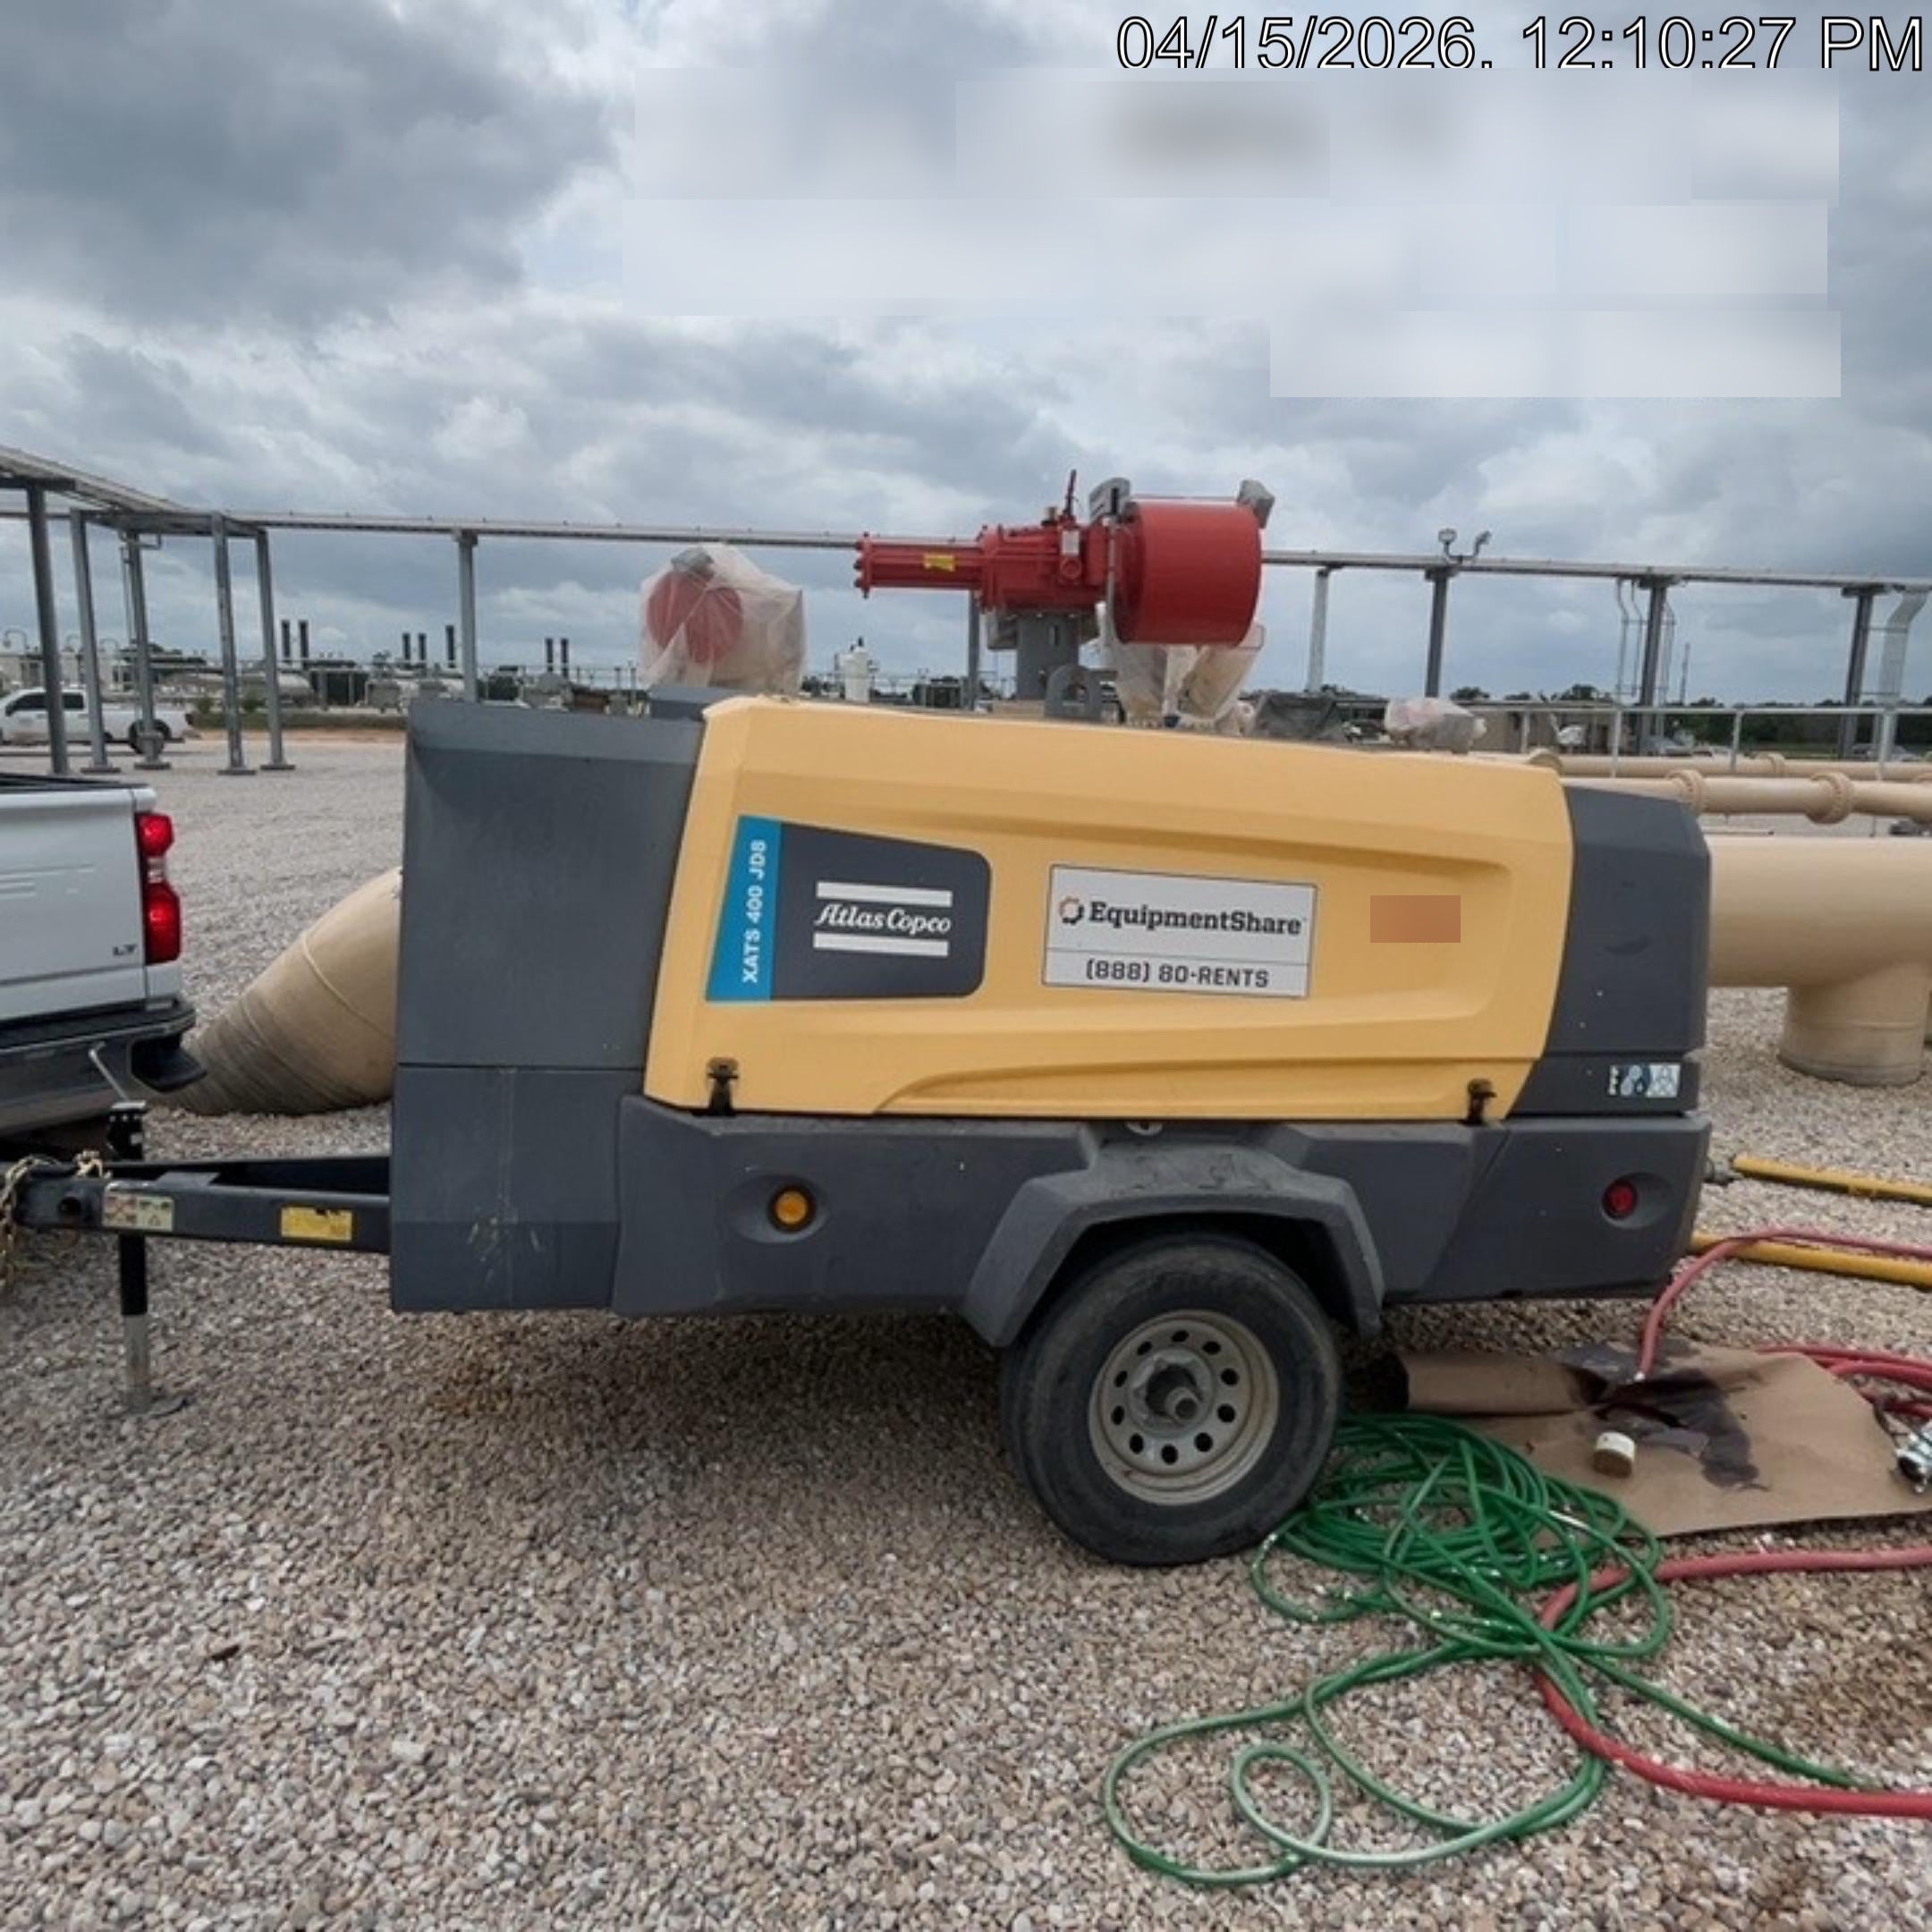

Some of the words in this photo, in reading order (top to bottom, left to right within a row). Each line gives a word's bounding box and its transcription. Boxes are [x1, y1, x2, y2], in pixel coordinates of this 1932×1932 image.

[747, 886, 764, 924] 400
[1089, 901, 1302, 935] EquipmentShare
[741, 929, 761, 983] XATS
[1086, 958, 1150, 982] (888)
[1158, 964, 1270, 987] 80-RENTS
